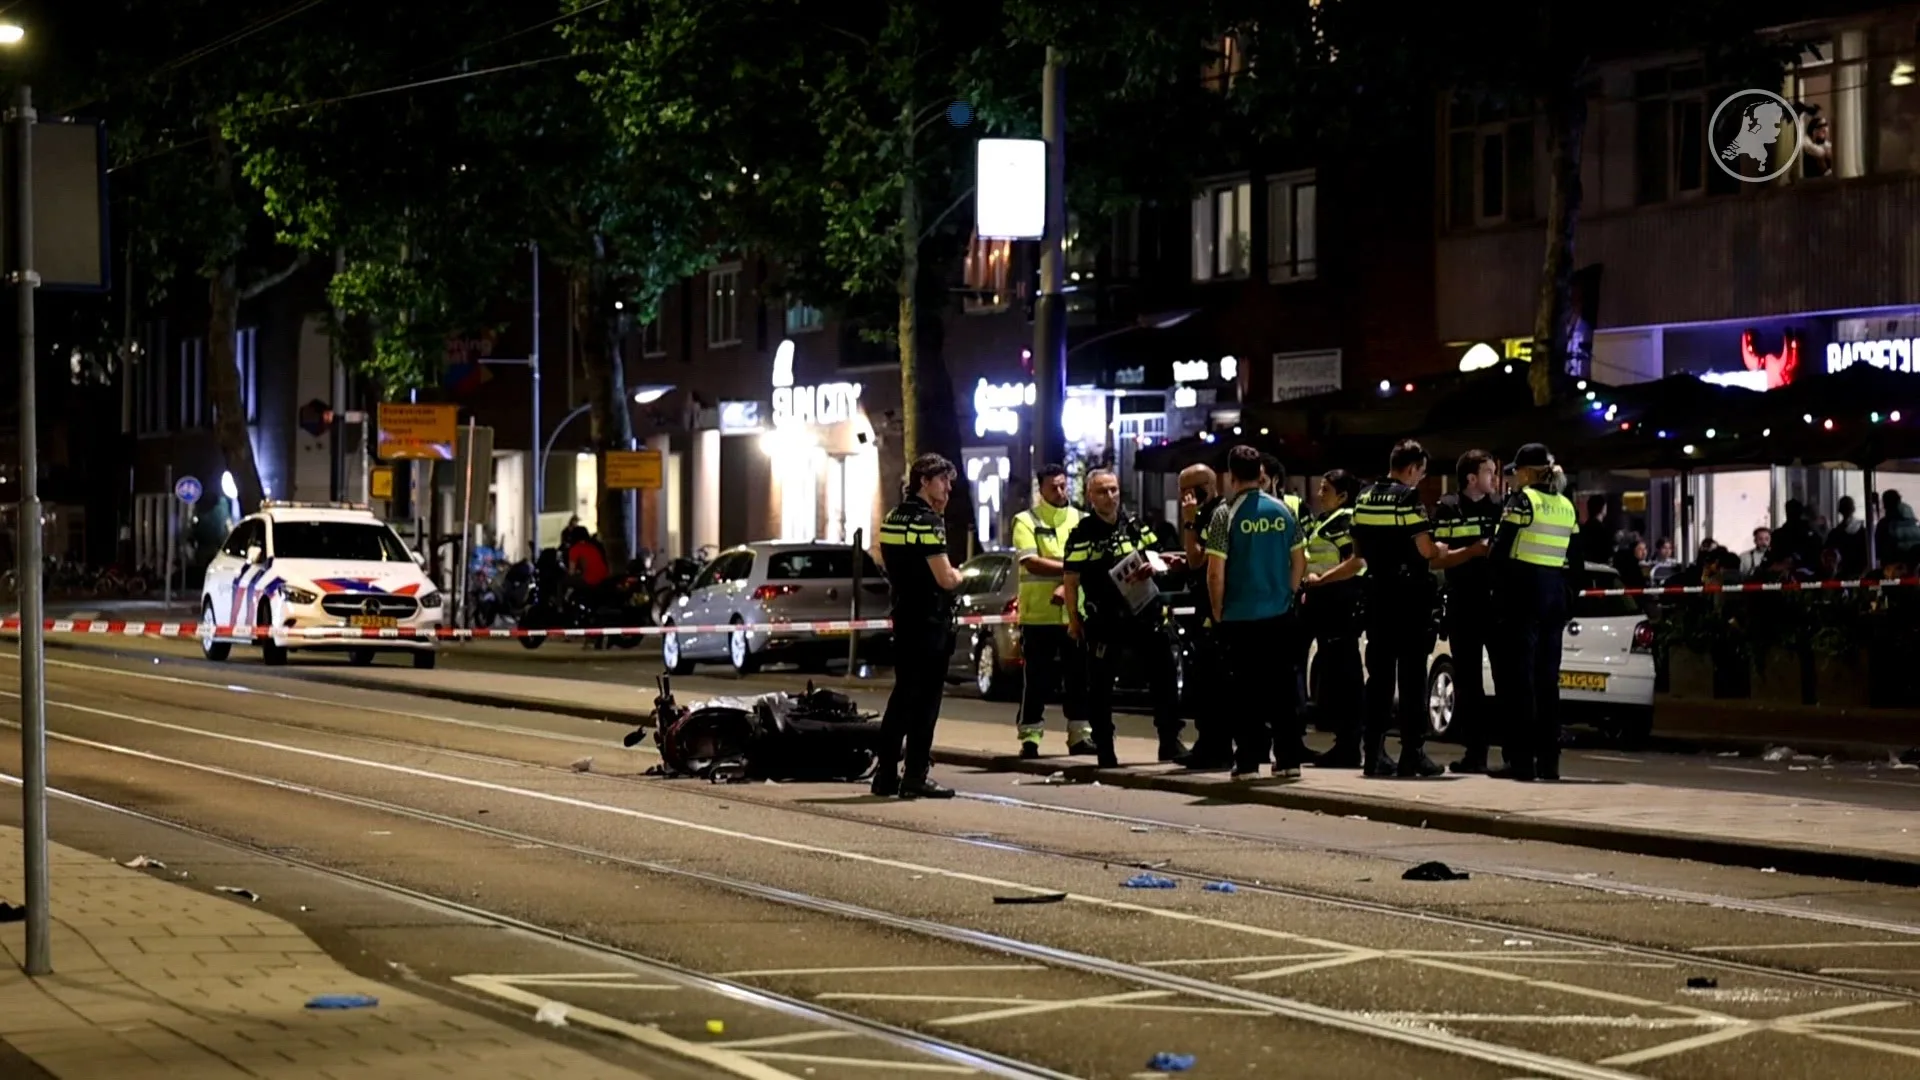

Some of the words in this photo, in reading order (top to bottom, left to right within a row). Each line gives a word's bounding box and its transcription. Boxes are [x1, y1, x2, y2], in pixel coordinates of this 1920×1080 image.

[772, 386, 816, 426] SUN
[817, 382, 862, 424] CITY
[1240, 516, 1286, 534] OvD-G
